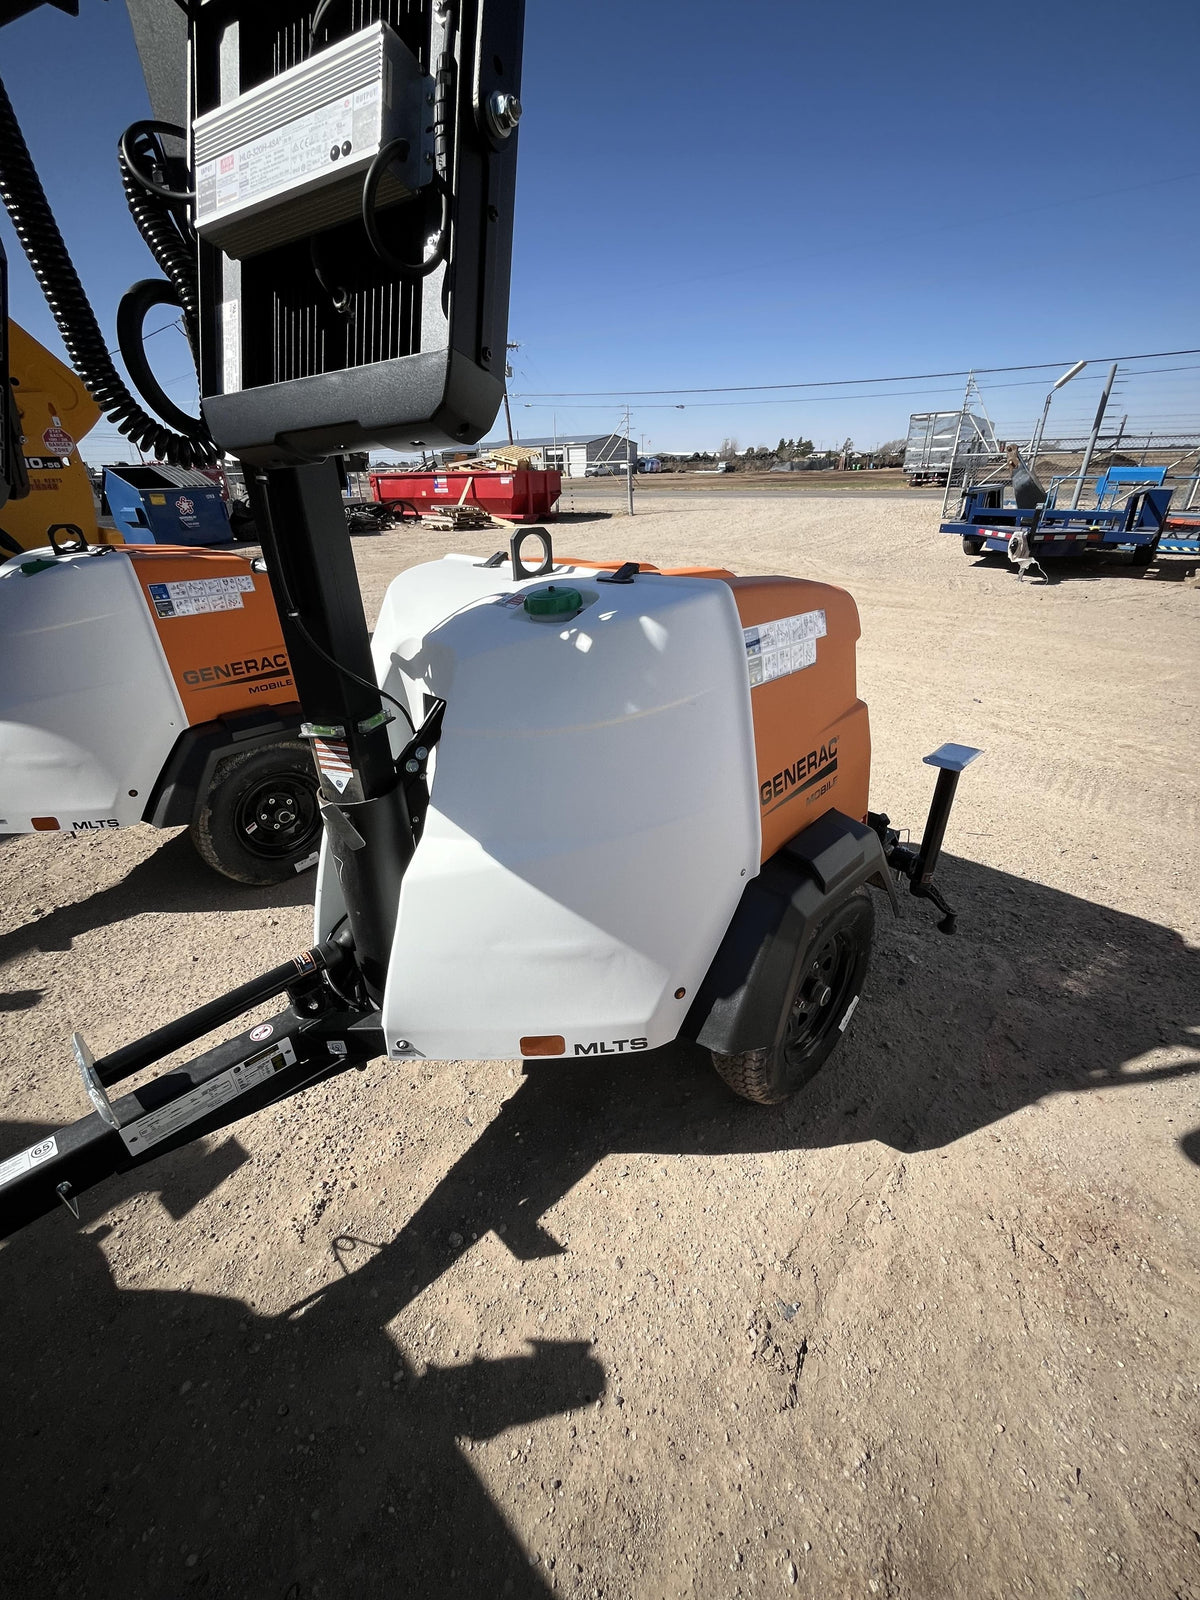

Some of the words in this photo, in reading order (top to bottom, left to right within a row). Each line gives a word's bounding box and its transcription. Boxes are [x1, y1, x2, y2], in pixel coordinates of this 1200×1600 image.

[182, 653, 288, 685] GENERAC
[248, 679, 294, 695] MOBILE
[760, 736, 839, 806] GENERAC
[805, 775, 838, 807] MOBILE
[72, 818, 120, 830] MLTS
[574, 1037, 648, 1056] MLTS
[34, 1143, 50, 1156] 65
